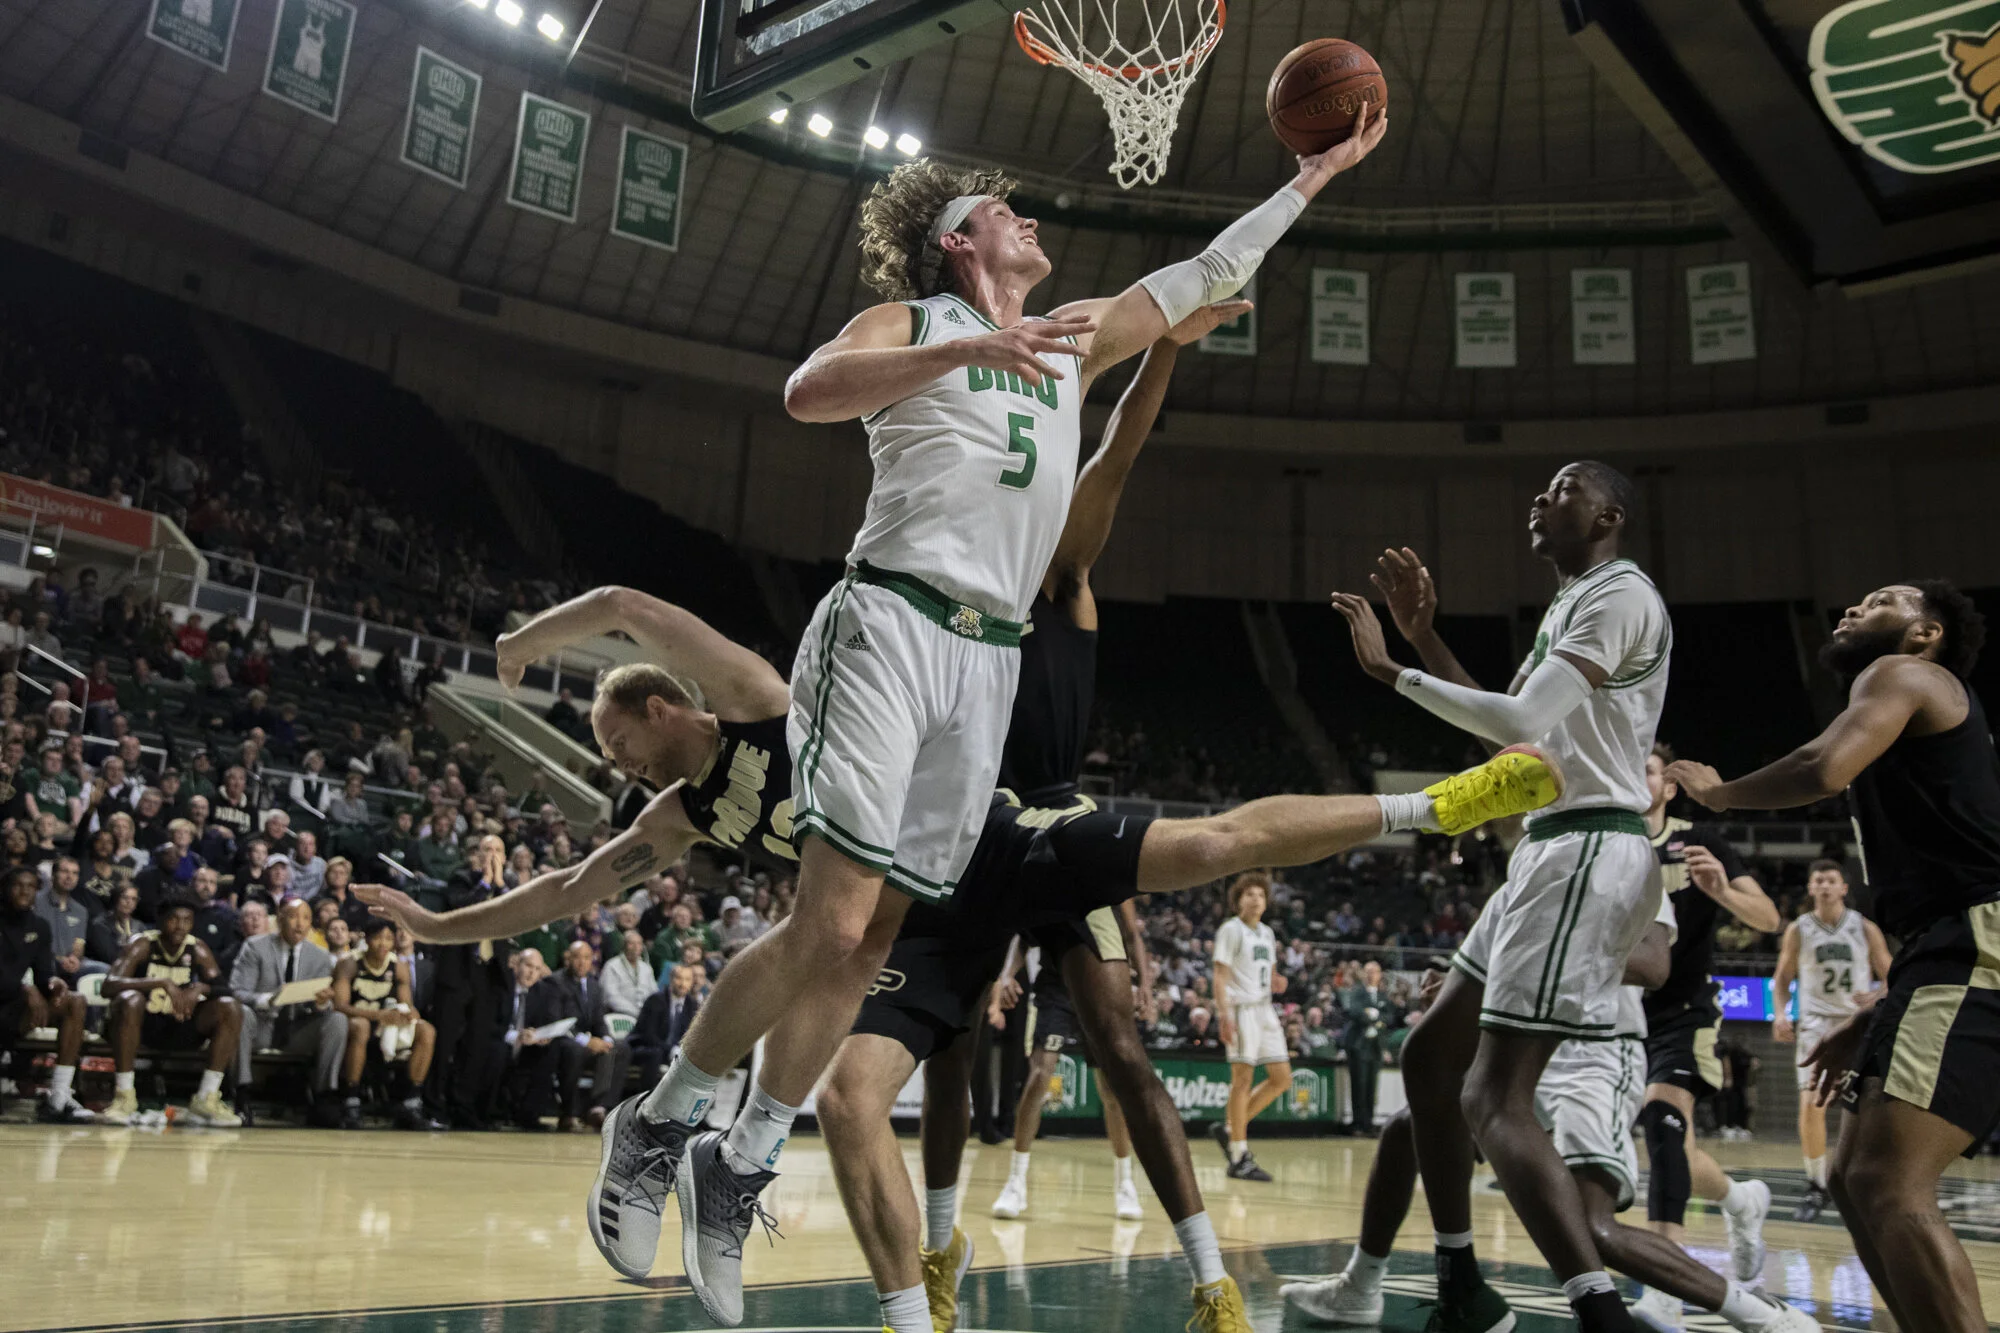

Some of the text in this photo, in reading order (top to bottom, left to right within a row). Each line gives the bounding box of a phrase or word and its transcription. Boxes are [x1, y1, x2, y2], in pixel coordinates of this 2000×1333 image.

[942, 314, 966, 326] adidas
[996, 411, 1038, 491] 5
[90, 508, 103, 525] it
[844, 642, 870, 651] adidas
[1822, 967, 1852, 994] 24
[1166, 1075, 1232, 1109] Holze
